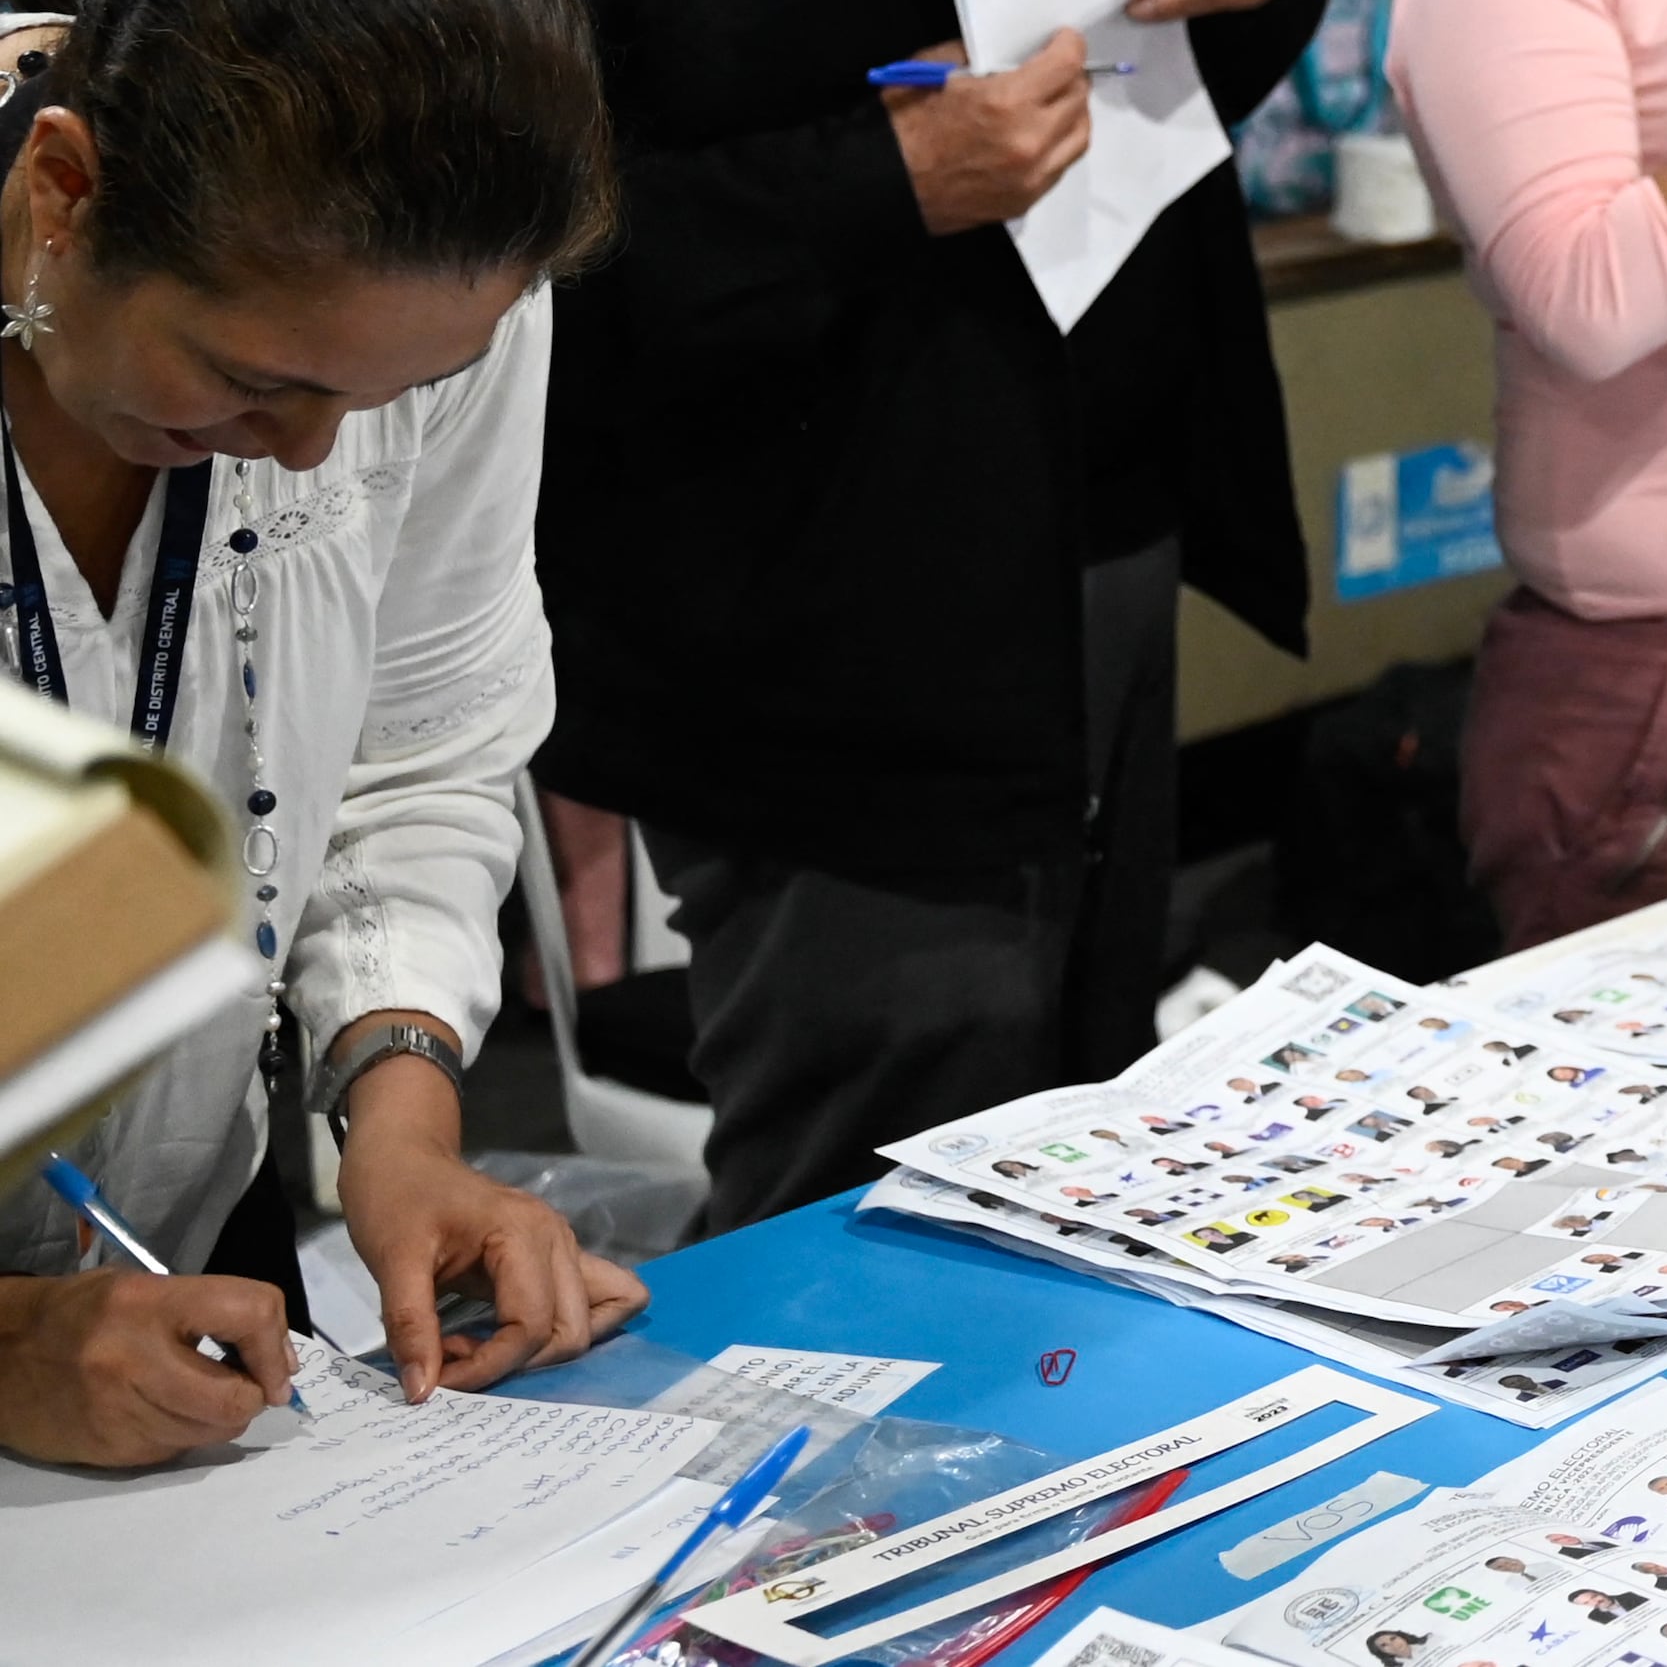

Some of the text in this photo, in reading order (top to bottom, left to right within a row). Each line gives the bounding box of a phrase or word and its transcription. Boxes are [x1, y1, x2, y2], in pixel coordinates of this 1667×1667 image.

[159, 588, 180, 649] CENTRAL
[29, 611, 48, 673] CENTRAL
[149, 652, 169, 710] DISTRITO
[145, 713, 160, 731] DE
[808, 1364, 826, 1376] EL
[832, 1360, 898, 1402] ADJUNTA
[842, 1360, 864, 1375] LA
[1253, 1405, 1288, 1422] 2023
[1549, 1427, 1626, 1480] ELECTORAL
[872, 1434, 1203, 1562] TRIBUNAL SUPREMO ELECTORAL
[1263, 1498, 1373, 1542] VOS
[1449, 1596, 1493, 1622] UNE
